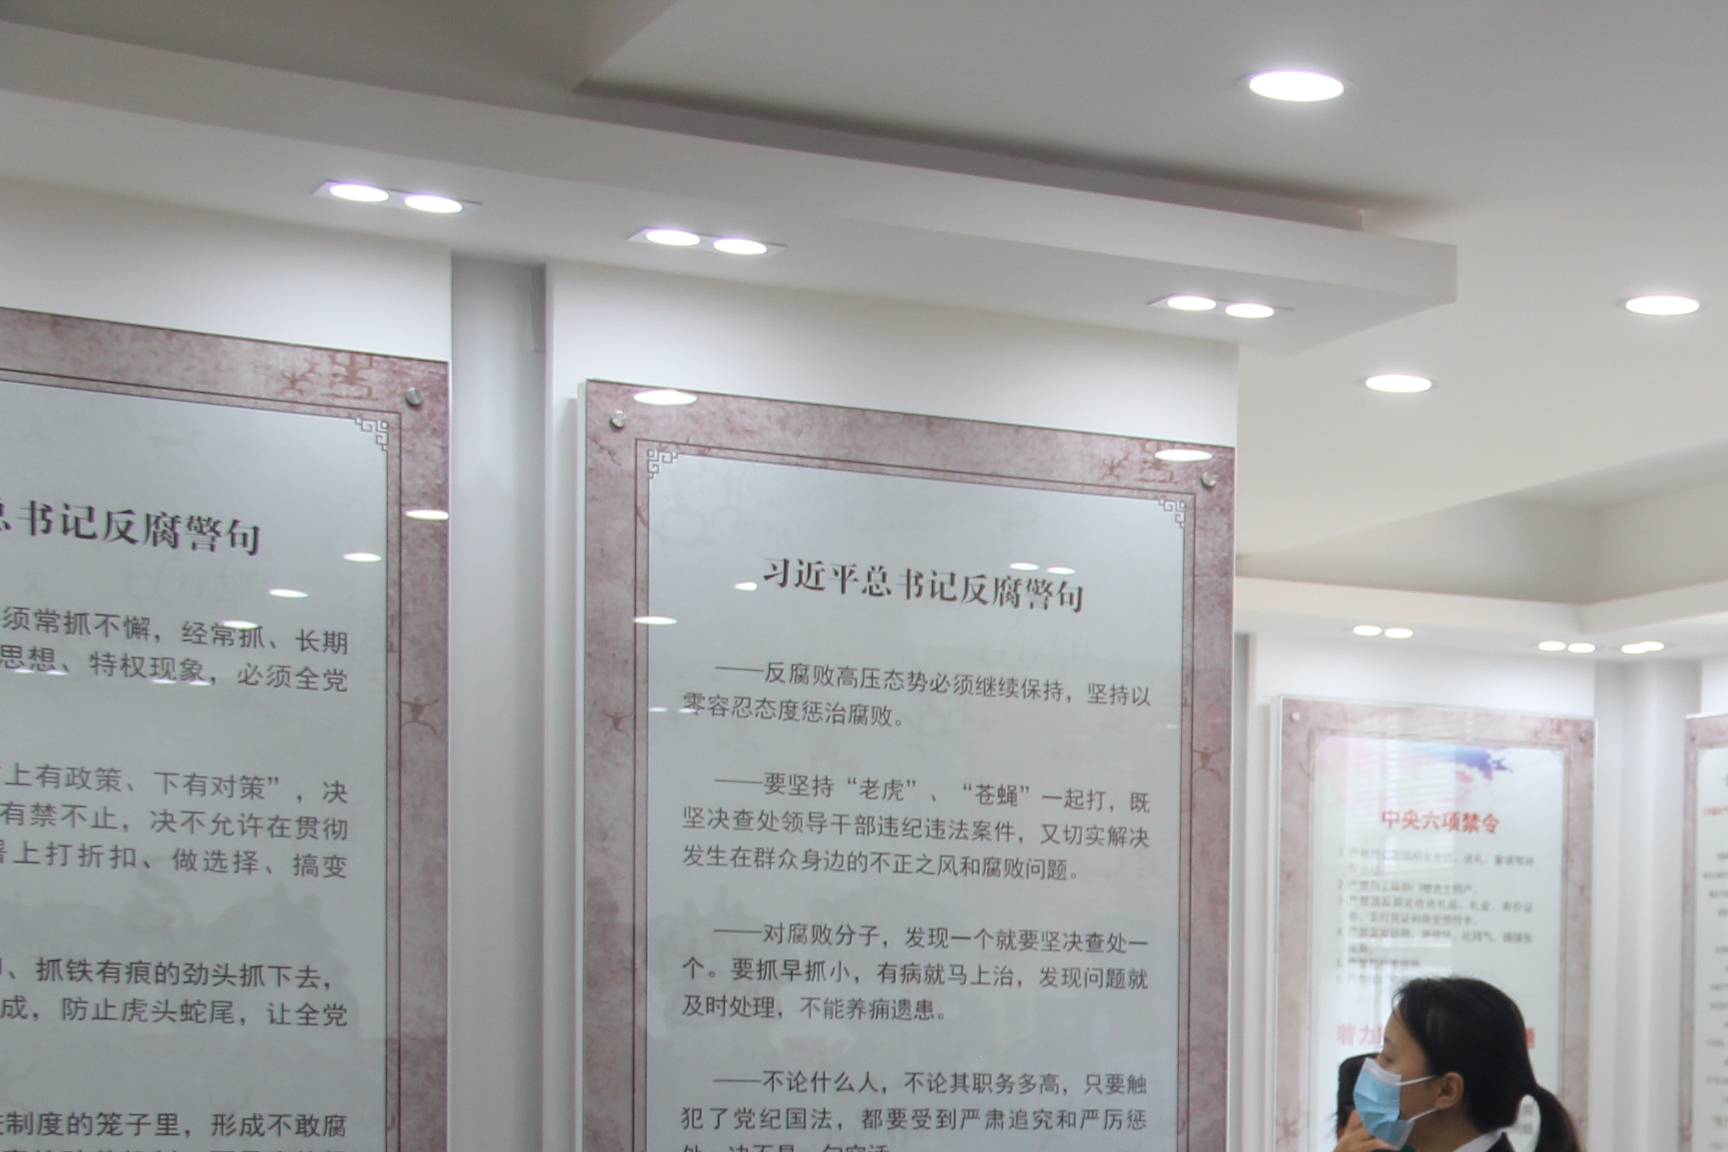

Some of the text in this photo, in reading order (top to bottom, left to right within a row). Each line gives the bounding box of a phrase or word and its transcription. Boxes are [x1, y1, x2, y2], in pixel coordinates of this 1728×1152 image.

[762, 557, 1085, 614] 习近平总书记反腐警句
[682, 691, 904, 729] 零容忍态度惩治腐败。
[682, 805, 1152, 849] 坚决查处领导干部违纪违法案件，又切实解决
[1381, 810, 1500, 834] 中央六项禁令
[0, 839, 348, 880] 上打折扣、做选择、搞变
[682, 843, 1081, 882] 发生在群众身边的不正之风和腐败问题。
[0, 956, 334, 991] 、抓铁有痕的劲头抓下去，
[682, 956, 1149, 991] 个。要抓早抓小，有病就马上治，发现问题就
[682, 994, 949, 1022] 及时处理，不能养痈遗患。
[0, 1111, 348, 1138] 制度的笼子里，形成不敢腐
[681, 1107, 1148, 1132] 犯了党纪国法，都要受到严肃追究和严厉惩
